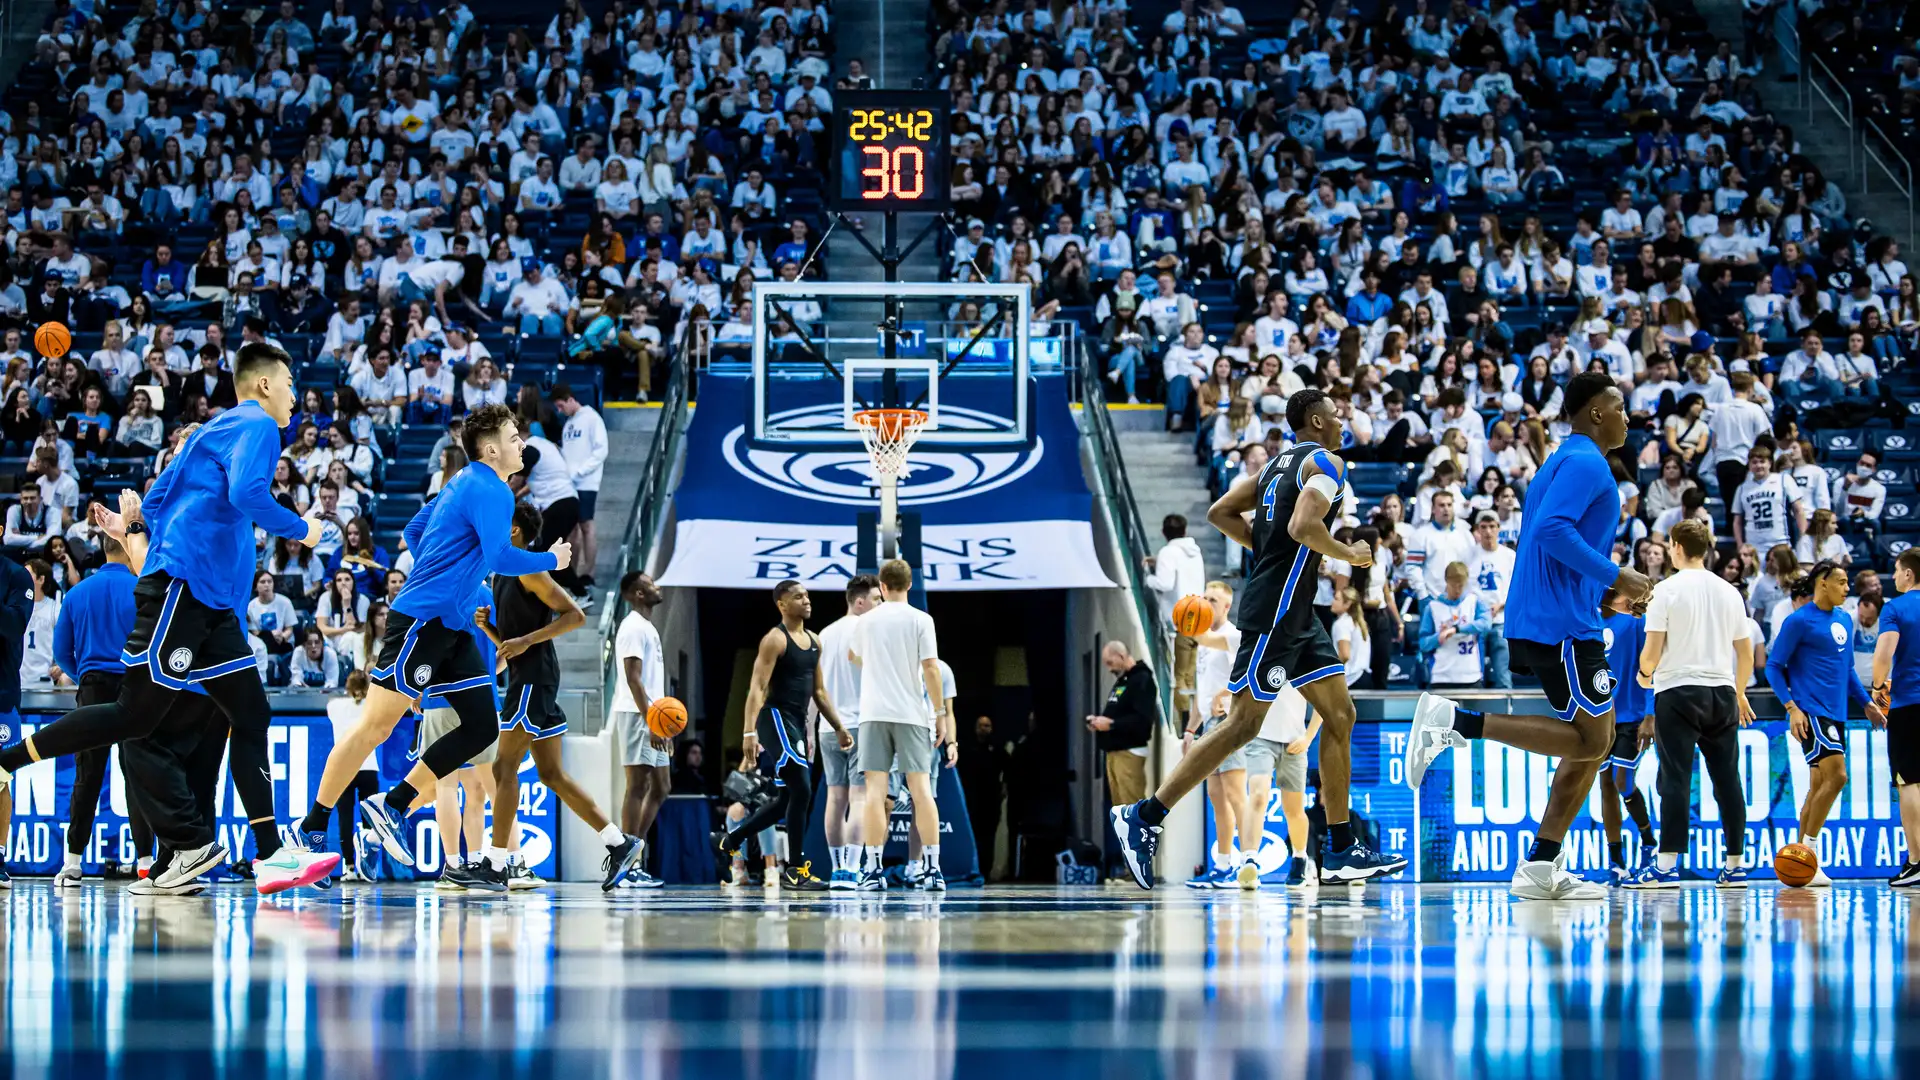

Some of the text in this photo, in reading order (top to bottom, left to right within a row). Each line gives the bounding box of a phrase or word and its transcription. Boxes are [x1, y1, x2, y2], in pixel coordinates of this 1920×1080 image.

[850, 110, 932, 141] 25:42
[862, 145, 924, 199] 30
[1263, 474, 1284, 521] 4
[1751, 501, 1772, 520] 32
[1453, 830, 1508, 872] AND
[1815, 827, 1866, 869] DAY
